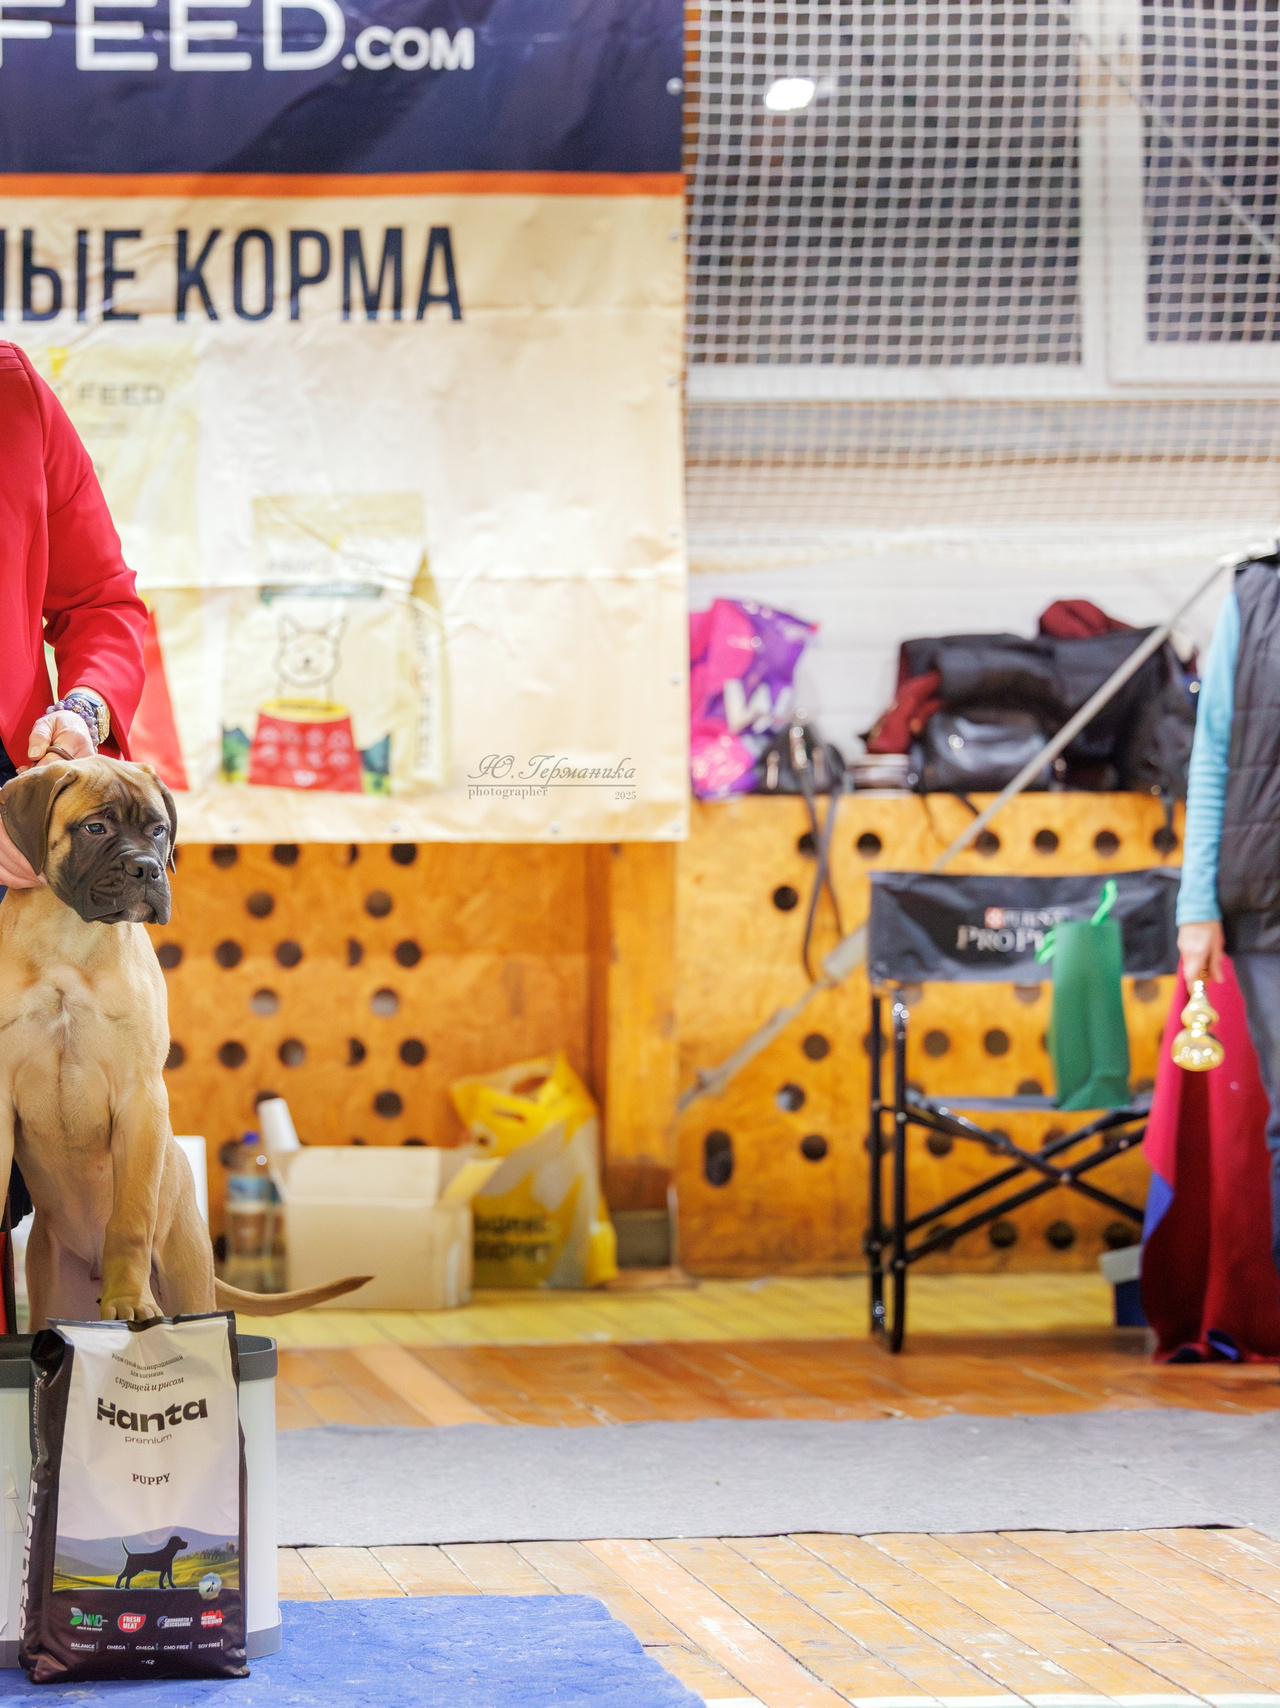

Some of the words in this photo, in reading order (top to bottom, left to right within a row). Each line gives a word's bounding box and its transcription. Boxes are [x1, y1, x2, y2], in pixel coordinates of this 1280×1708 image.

[176, 226, 464, 323] КОРМА
[119, 1378, 150, 1392] курицей
[158, 1376, 185, 1391] рисом
[97, 1397, 208, 1433] Hanta
[124, 1433, 173, 1445] premium
[132, 1472, 171, 1485] PUPPY
[123, 1615, 141, 1623] FRESH
[123, 1622, 138, 1630] MEAT
